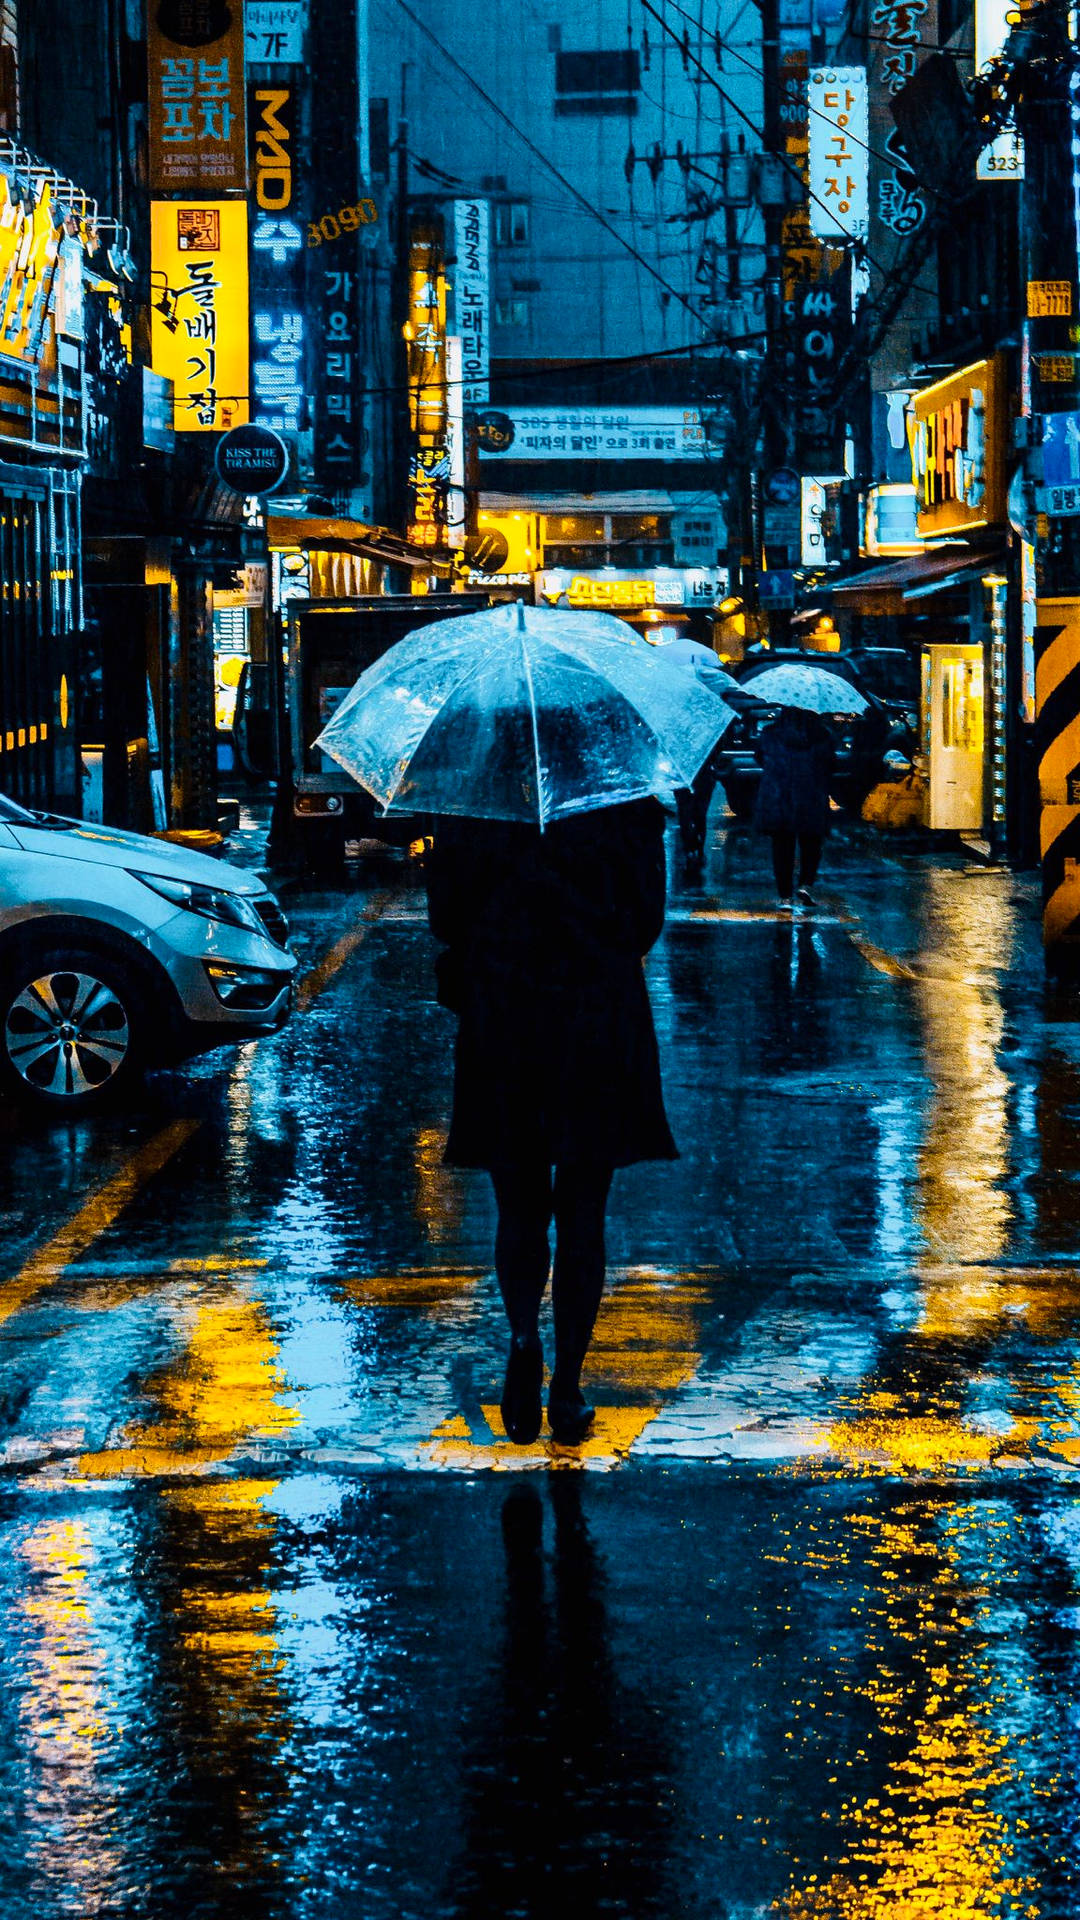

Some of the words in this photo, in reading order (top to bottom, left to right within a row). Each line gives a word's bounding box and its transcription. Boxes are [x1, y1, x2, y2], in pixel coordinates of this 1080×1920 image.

[261, 33, 288, 57] 7F
[161, 101, 236, 142] 포차
[824, 89, 857, 213] 당구장
[325, 271, 353, 462] 가요리믹스
[226, 447, 252, 458] KISS
[253, 447, 278, 458] THE
[1051, 486, 1080, 511] 일방
